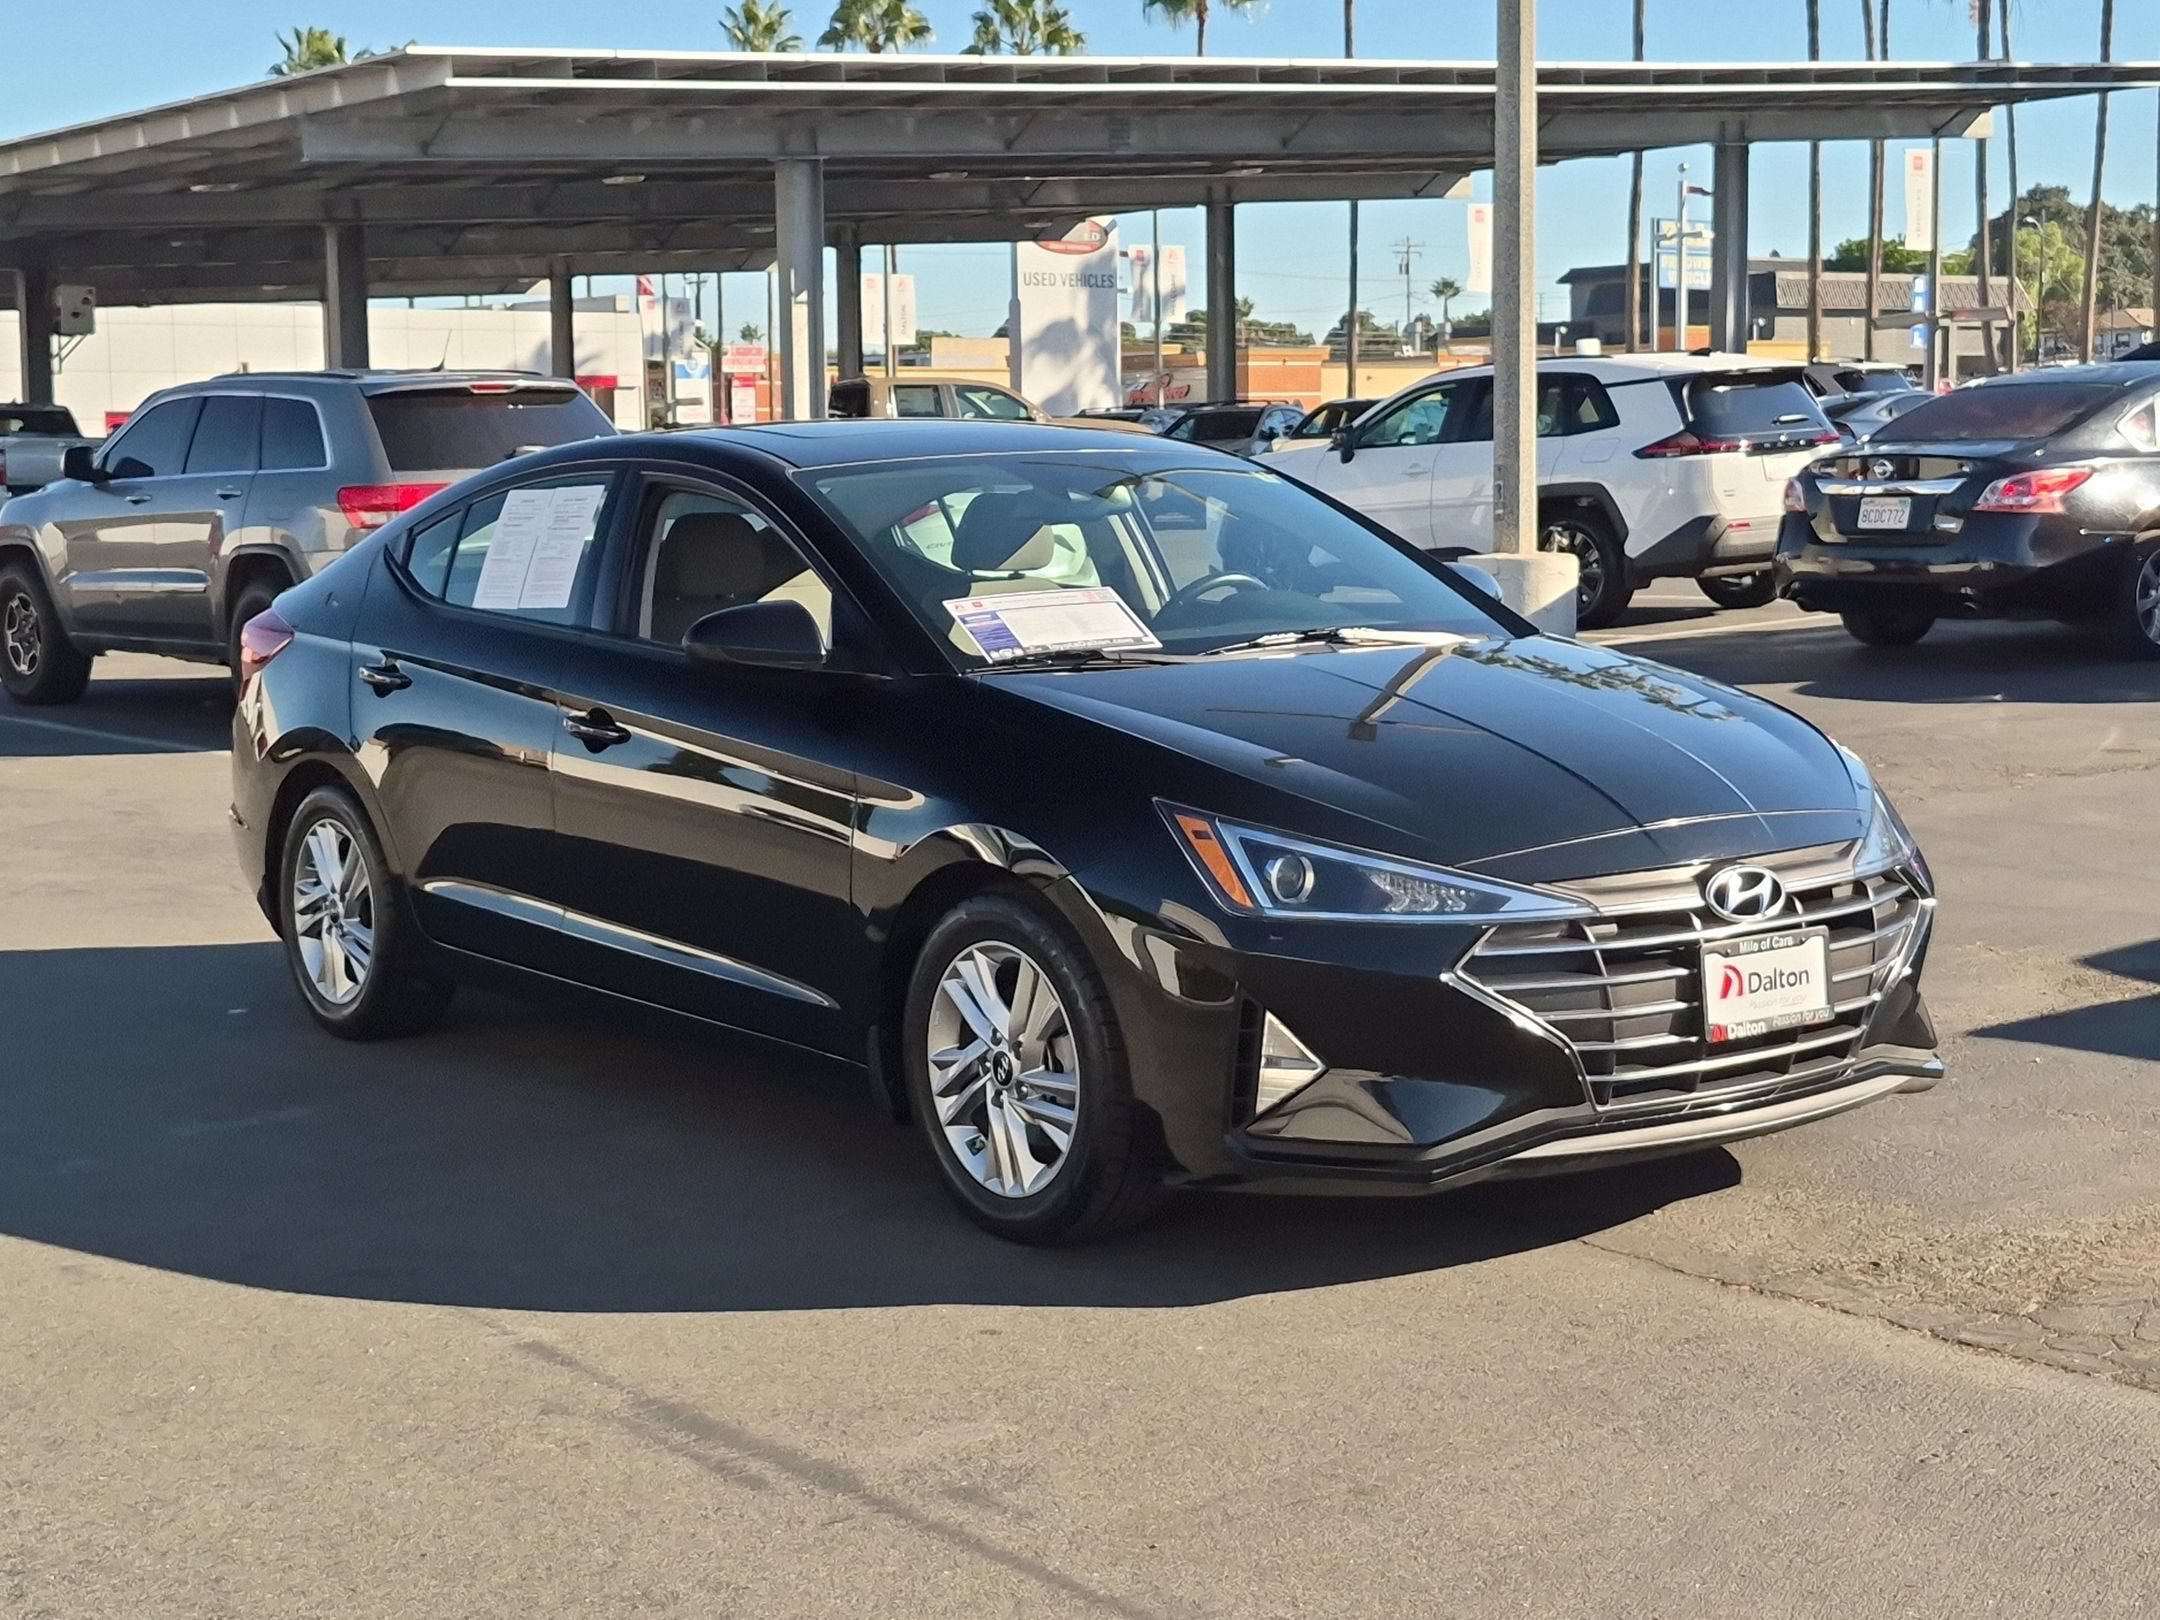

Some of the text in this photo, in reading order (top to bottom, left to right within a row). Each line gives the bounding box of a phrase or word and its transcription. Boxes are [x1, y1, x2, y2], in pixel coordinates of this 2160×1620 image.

[1023, 272, 1115, 289] USED VEHICLES
[1739, 935, 1794, 953] Mile of Cars
[1748, 967, 1810, 994] Dalton
[1727, 1021, 1767, 1039] Dalton
[1803, 1010, 1814, 1022] for
[1814, 1007, 1830, 1021] you
